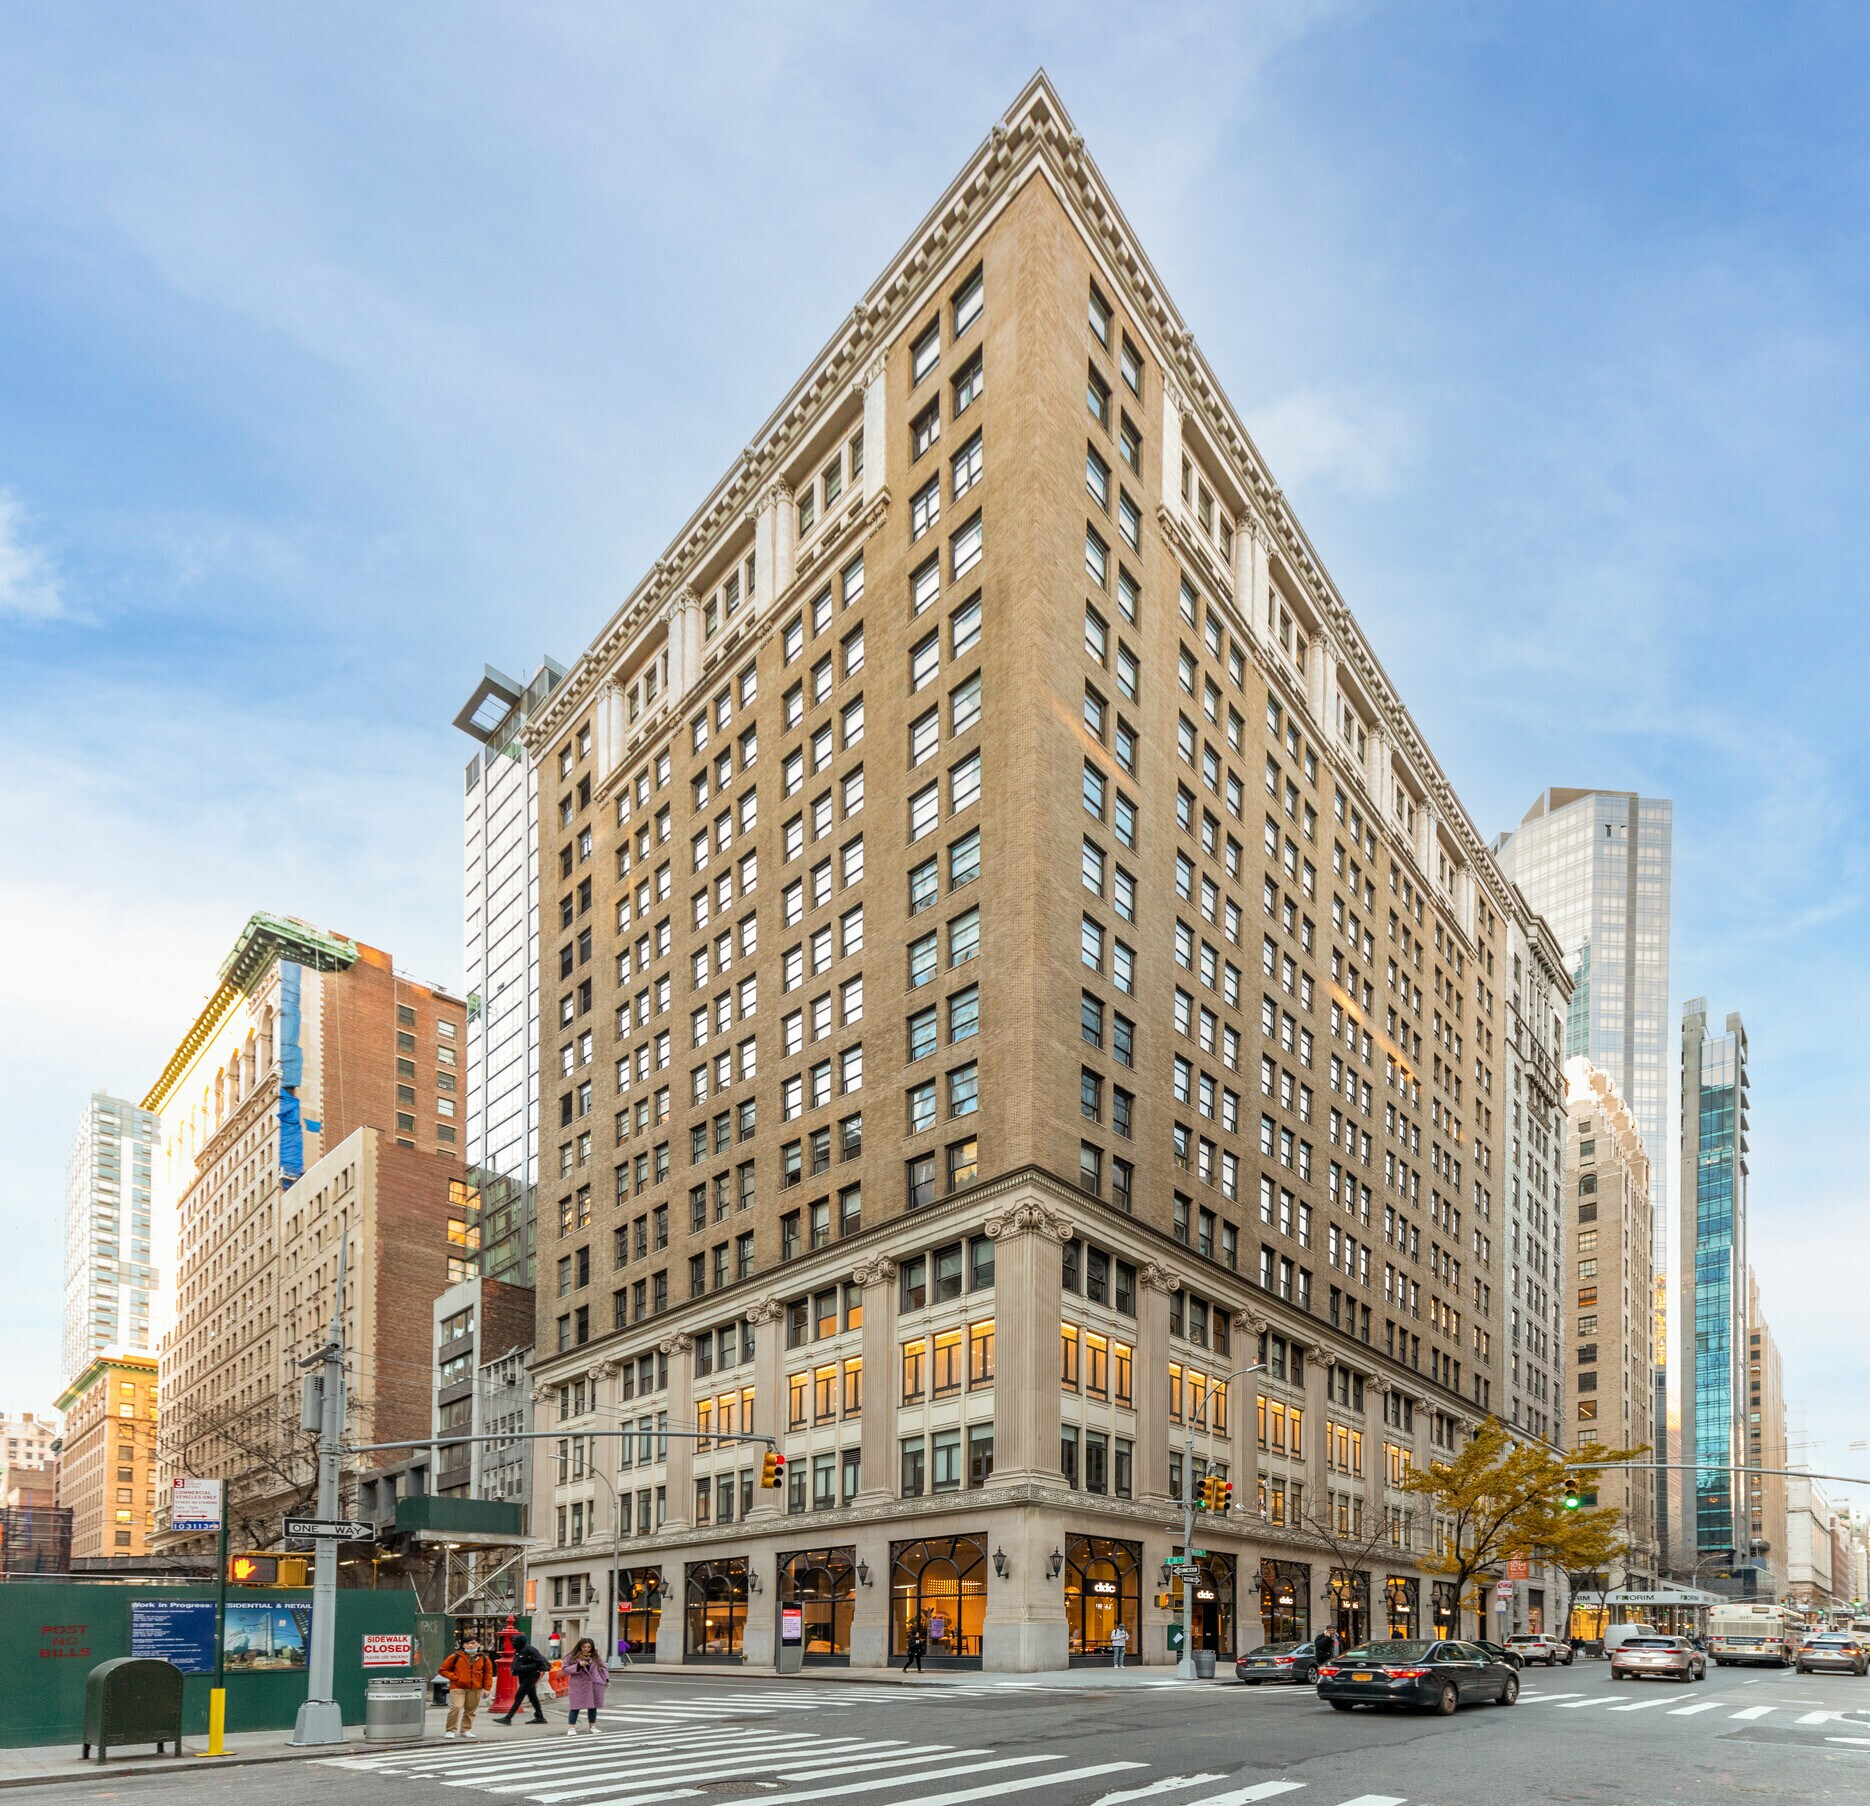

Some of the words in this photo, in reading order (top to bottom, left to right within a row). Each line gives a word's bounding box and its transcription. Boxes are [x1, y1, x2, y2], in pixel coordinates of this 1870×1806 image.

[292, 1525, 320, 1533] ONE
[334, 1526, 363, 1535] WAY
[1094, 1582, 1116, 1593] ddc
[1197, 1590, 1214, 1599] ddc
[1279, 1596, 1293, 1604] ddc
[41, 1625, 88, 1635] POST
[52, 1637, 78, 1646] NO
[367, 1635, 408, 1643] SIDEWALK
[40, 1647, 90, 1658] BILLS
[363, 1644, 411, 1653] CLOSED
